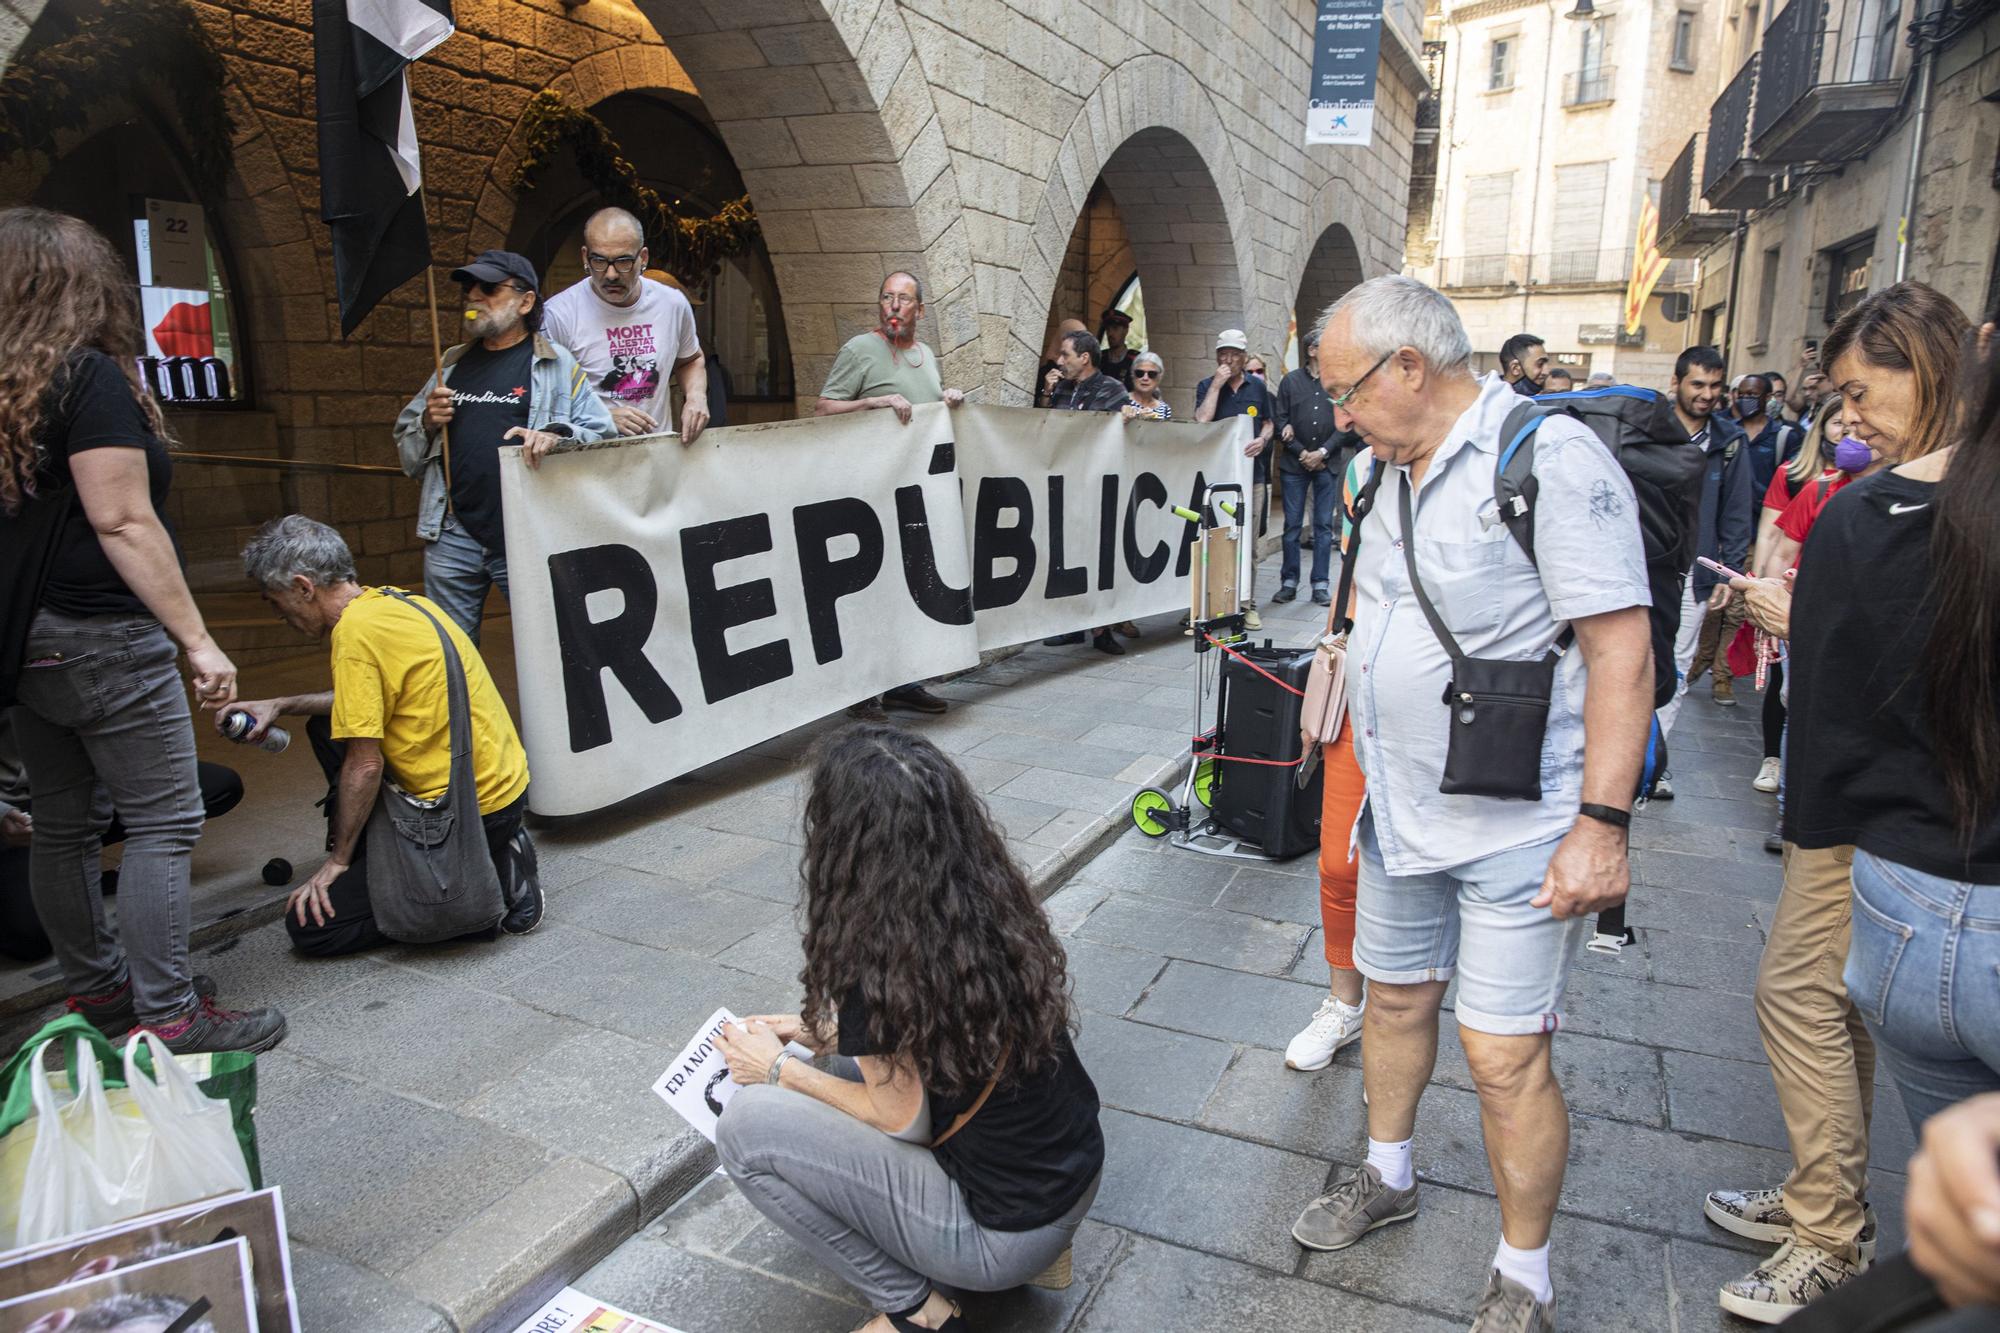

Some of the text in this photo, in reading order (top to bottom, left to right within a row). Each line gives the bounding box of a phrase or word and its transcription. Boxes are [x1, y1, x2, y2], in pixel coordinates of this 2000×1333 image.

[1336, 22, 1353, 30] Rosa
[165, 217, 189, 233] 22
[606, 324, 653, 341] MORT
[609, 345, 657, 358] FEIXISTA
[547, 442, 1219, 754] REPÚBLICA
